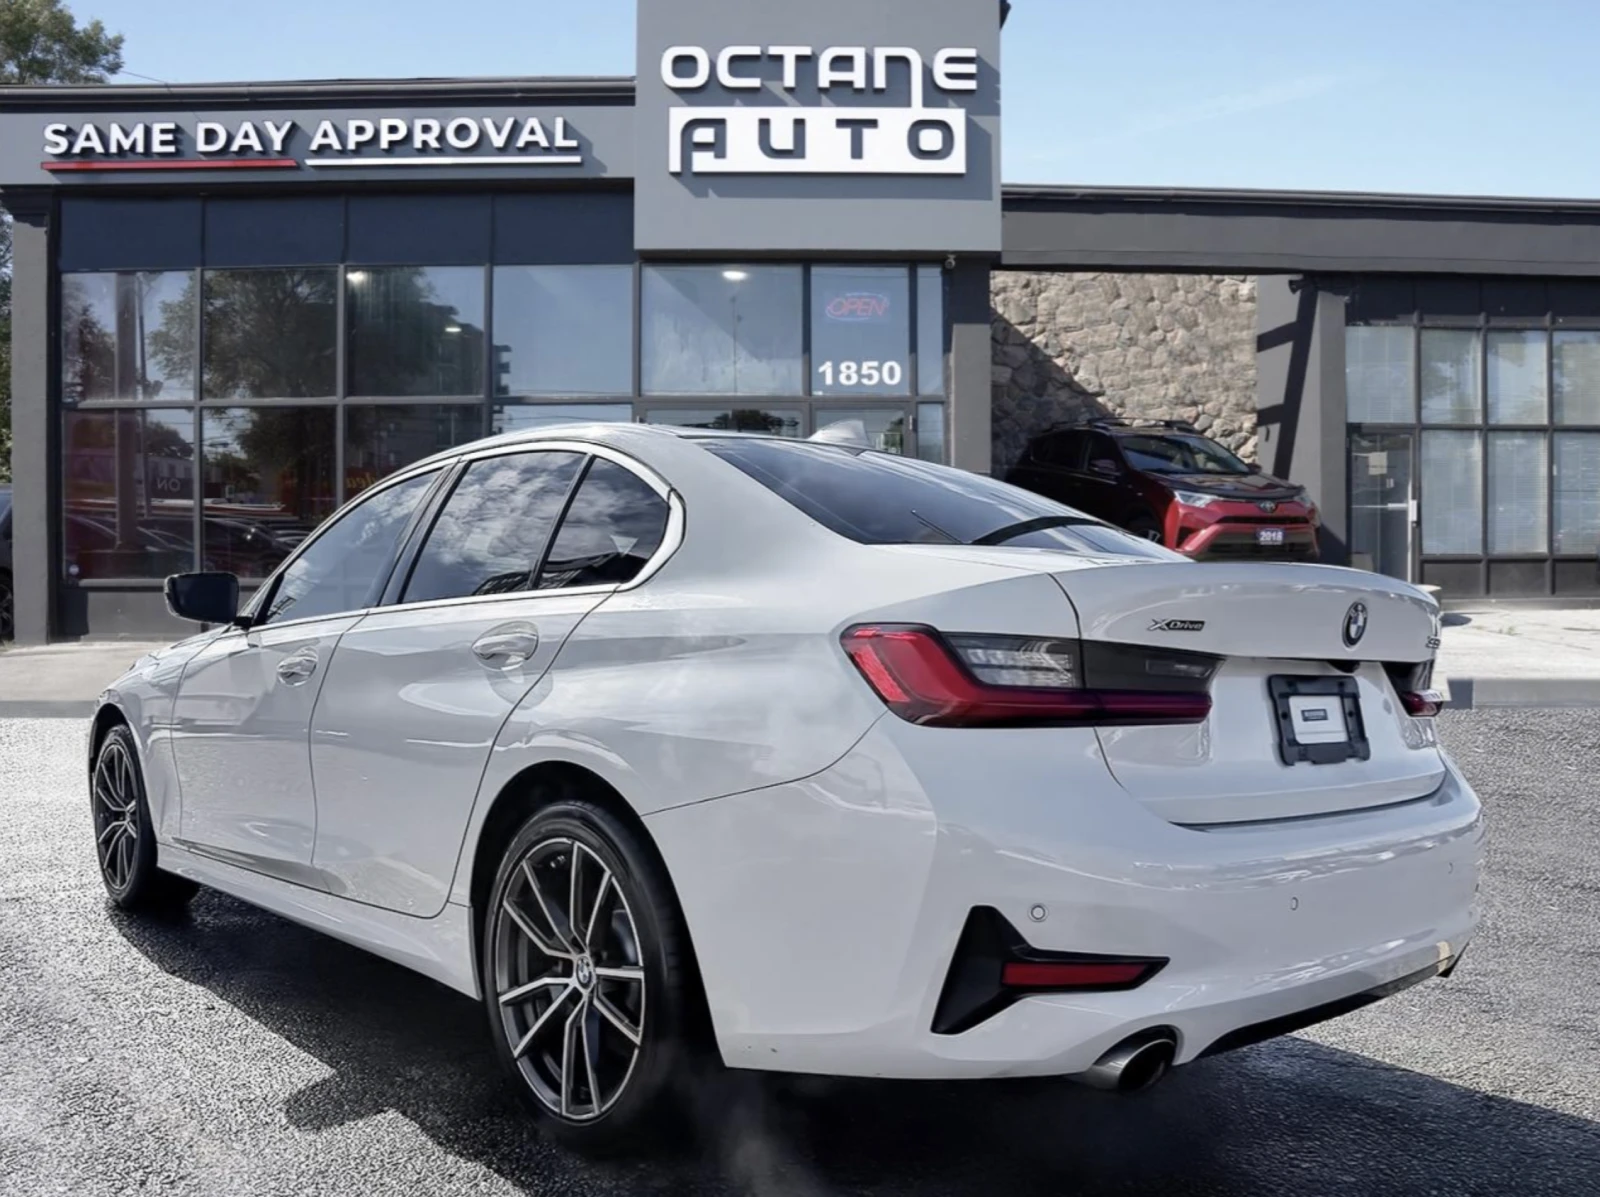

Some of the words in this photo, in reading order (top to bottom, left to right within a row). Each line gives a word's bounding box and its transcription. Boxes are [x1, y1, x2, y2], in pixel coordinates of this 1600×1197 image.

[660, 46, 977, 107] OCTANE
[43, 122, 176, 154] SAME
[196, 121, 292, 153] DAY
[309, 116, 579, 150] APPROVAL
[680, 118, 955, 172] AUTO
[827, 296, 886, 316] OPEN
[818, 361, 901, 386] 1850
